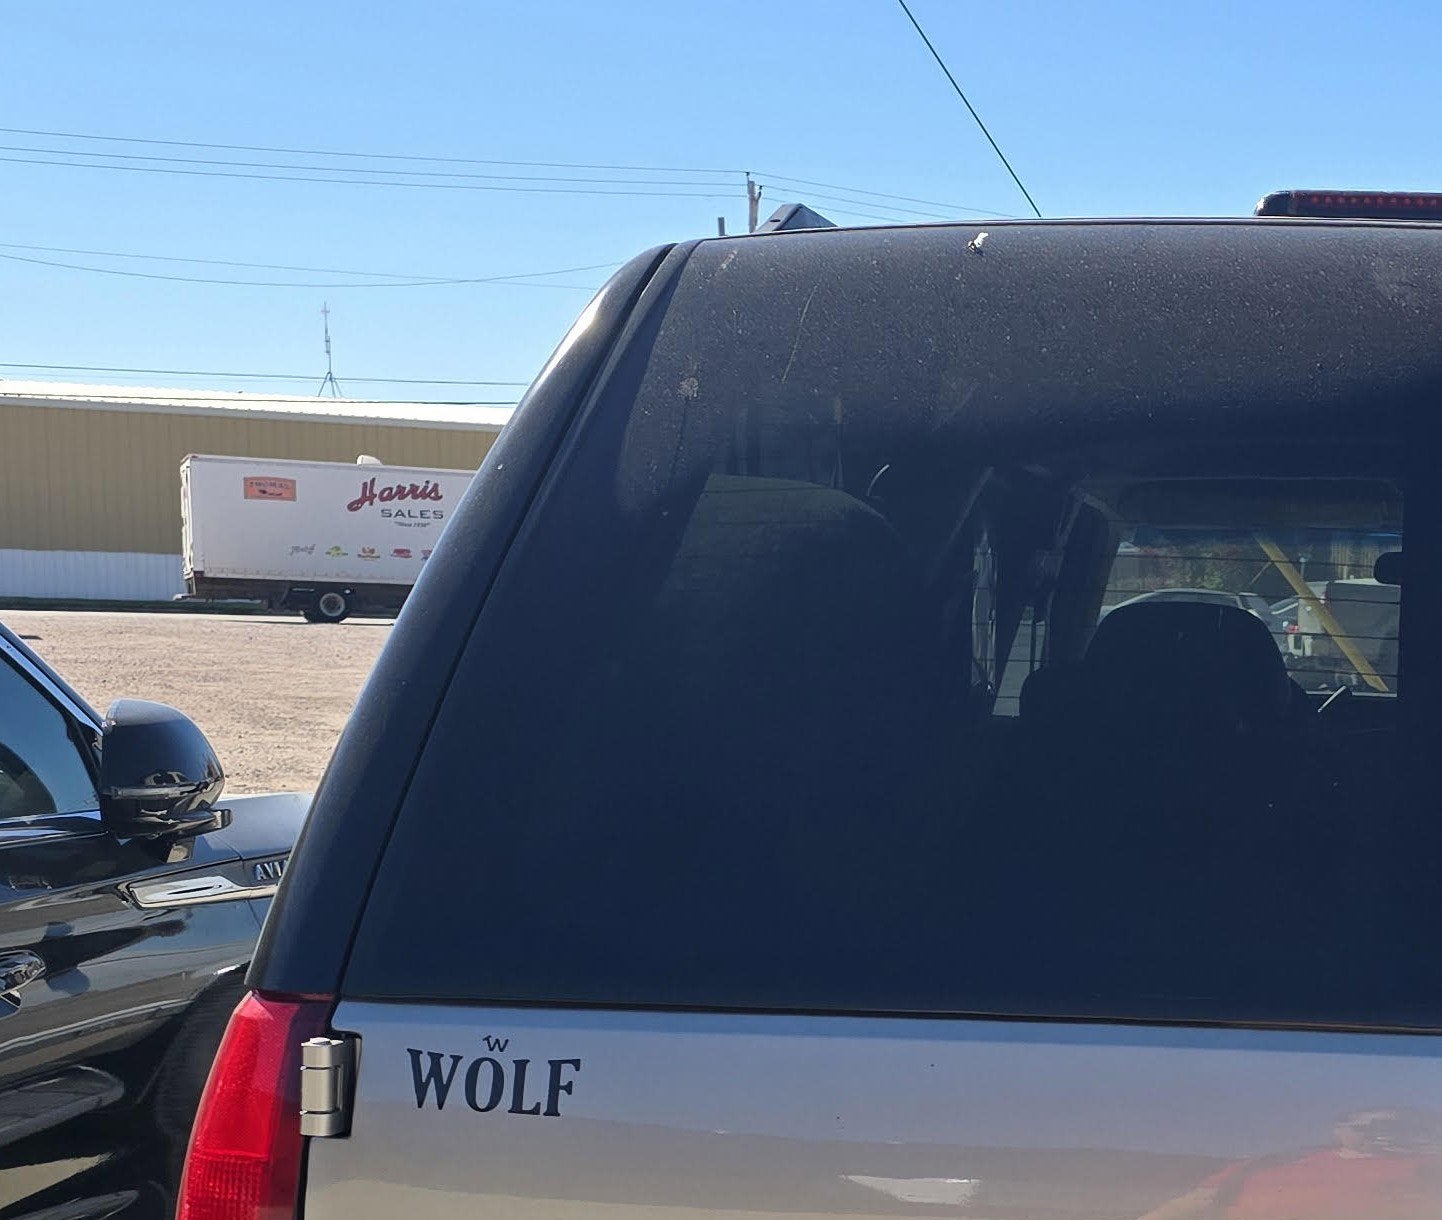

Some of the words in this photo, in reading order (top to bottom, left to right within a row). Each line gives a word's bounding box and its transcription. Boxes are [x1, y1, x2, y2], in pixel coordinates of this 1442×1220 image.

[347, 477, 443, 512] Harris
[380, 509, 444, 520] SALES
[406, 1047, 581, 1117] WOLF
